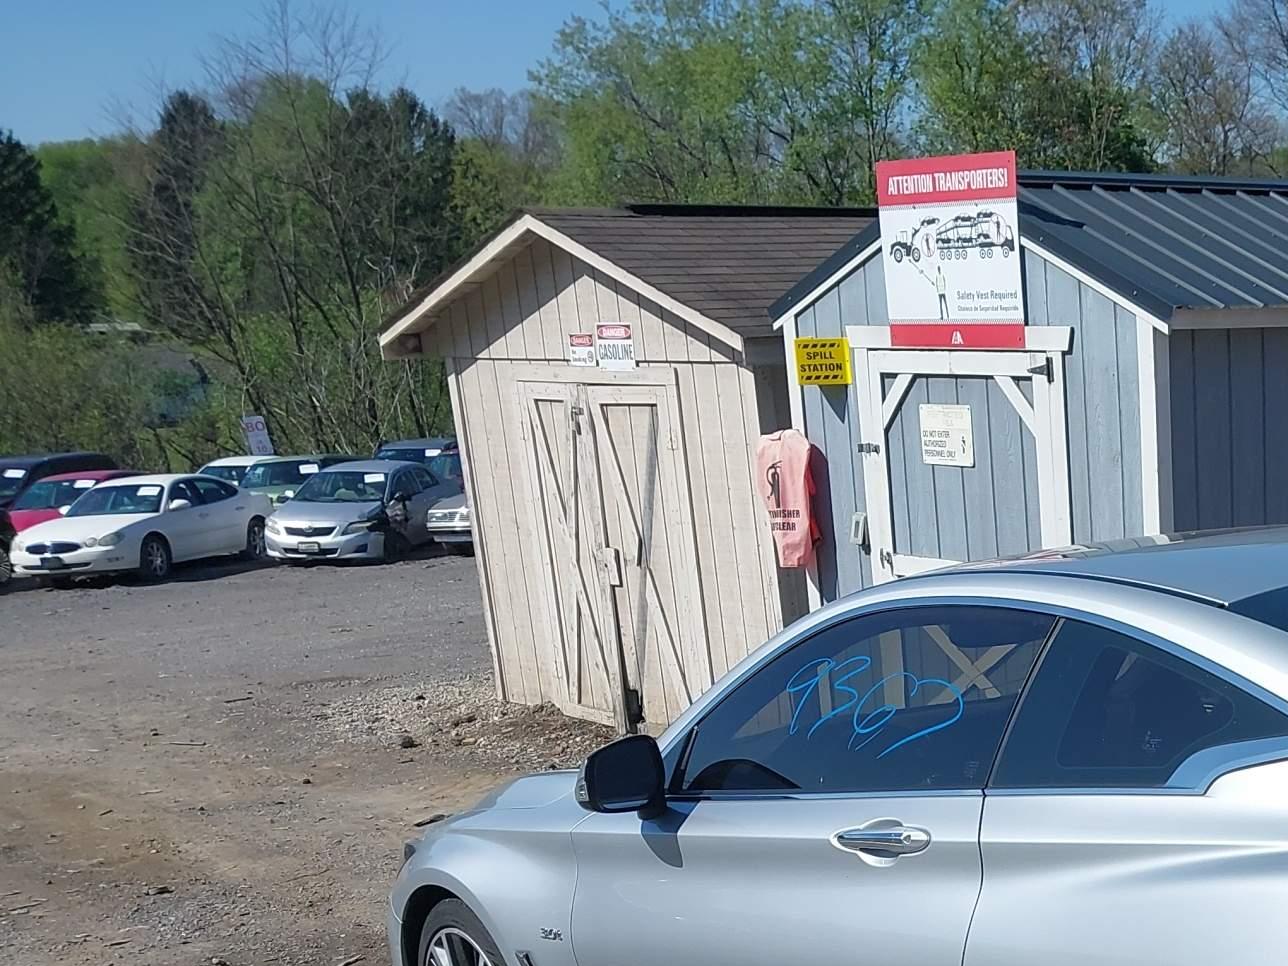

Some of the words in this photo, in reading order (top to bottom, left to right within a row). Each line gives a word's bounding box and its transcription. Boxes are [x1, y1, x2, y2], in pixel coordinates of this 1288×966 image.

[888, 174, 933, 195] ATTENTION
[934, 168, 1008, 191] TRANSPORTERS!
[957, 290, 975, 301] Safety
[976, 290, 989, 300] Vest
[990, 289, 1018, 301] Required
[602, 327, 626, 337] DANGER
[598, 344, 634, 360] GASOLINE
[806, 351, 835, 360] SPILL
[800, 363, 843, 373] STATION
